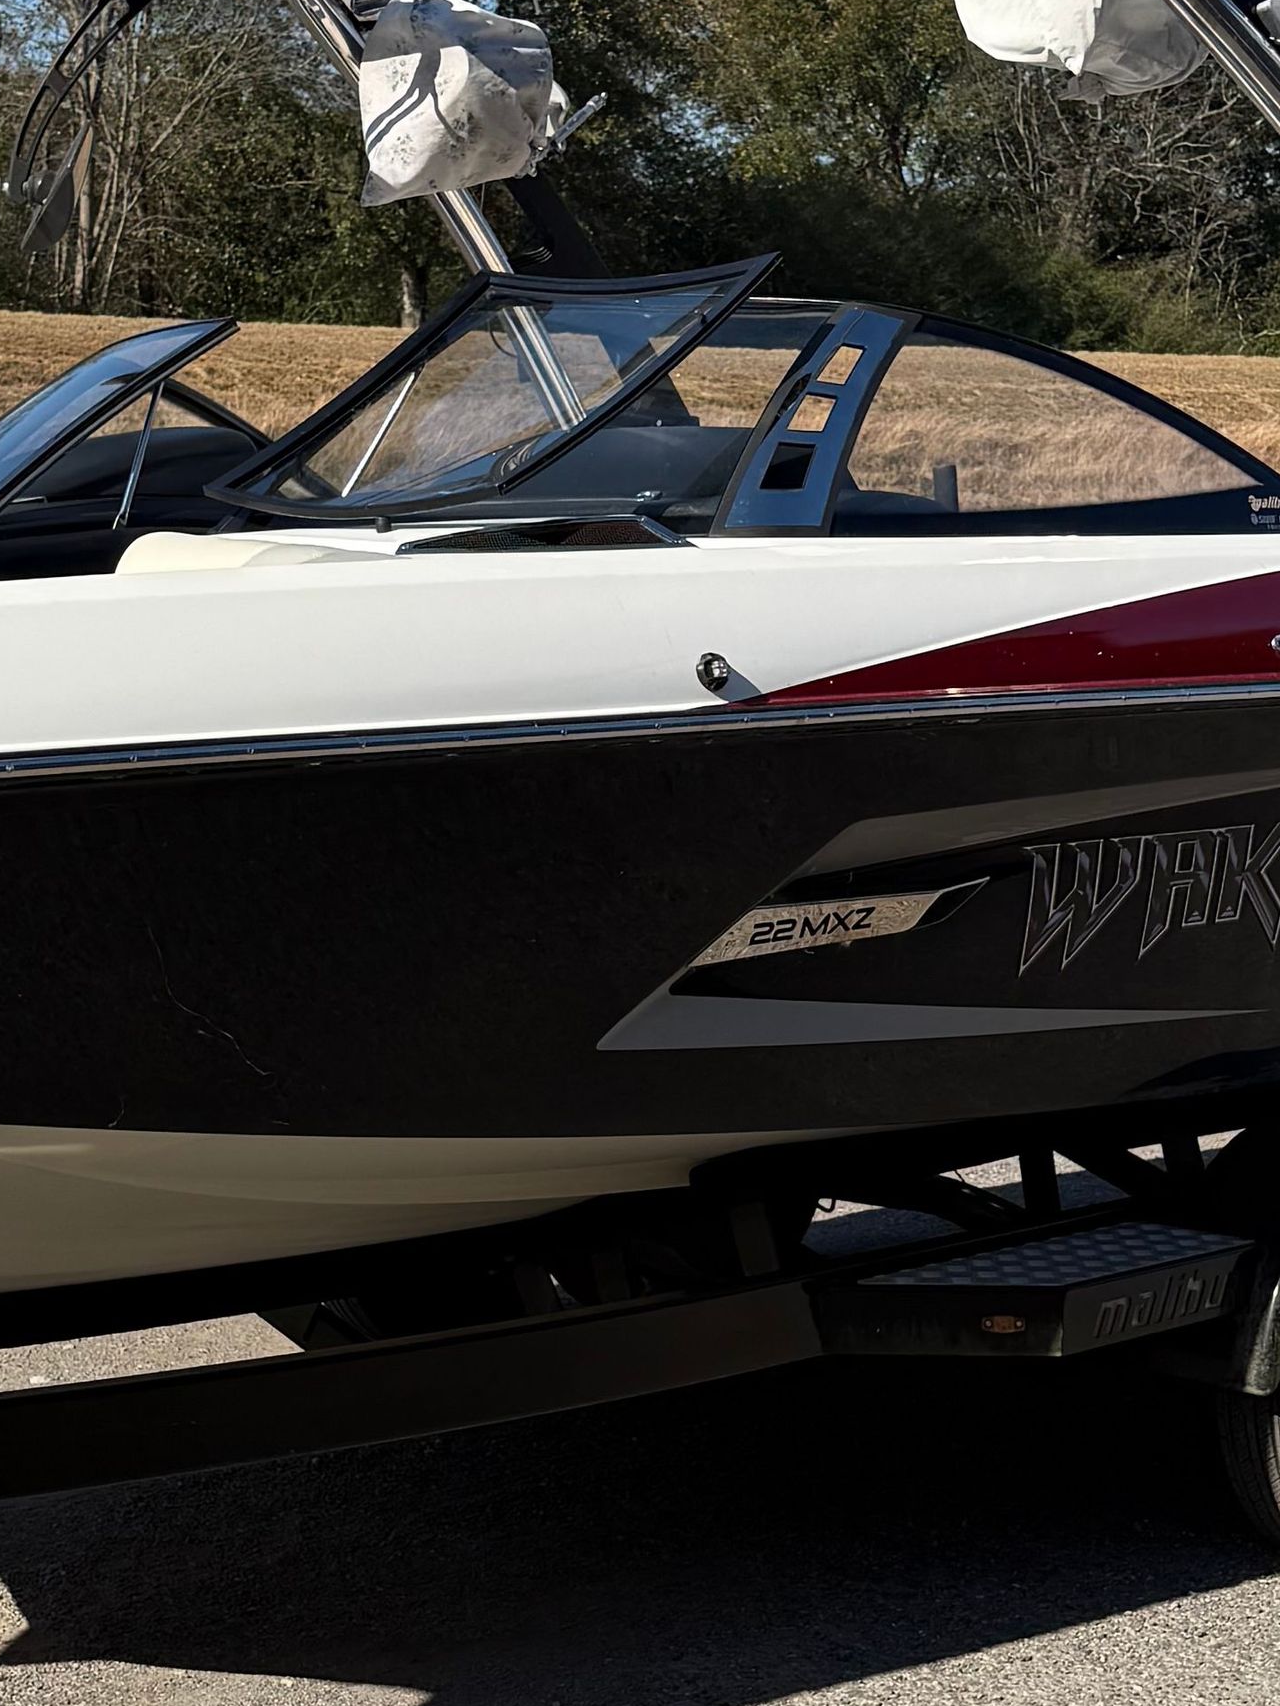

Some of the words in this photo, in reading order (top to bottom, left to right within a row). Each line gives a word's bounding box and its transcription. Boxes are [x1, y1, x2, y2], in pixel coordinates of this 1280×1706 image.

[749, 918, 797, 946] 22
[799, 906, 876, 939] MXZ
[1094, 1270, 1232, 1338] malibu
